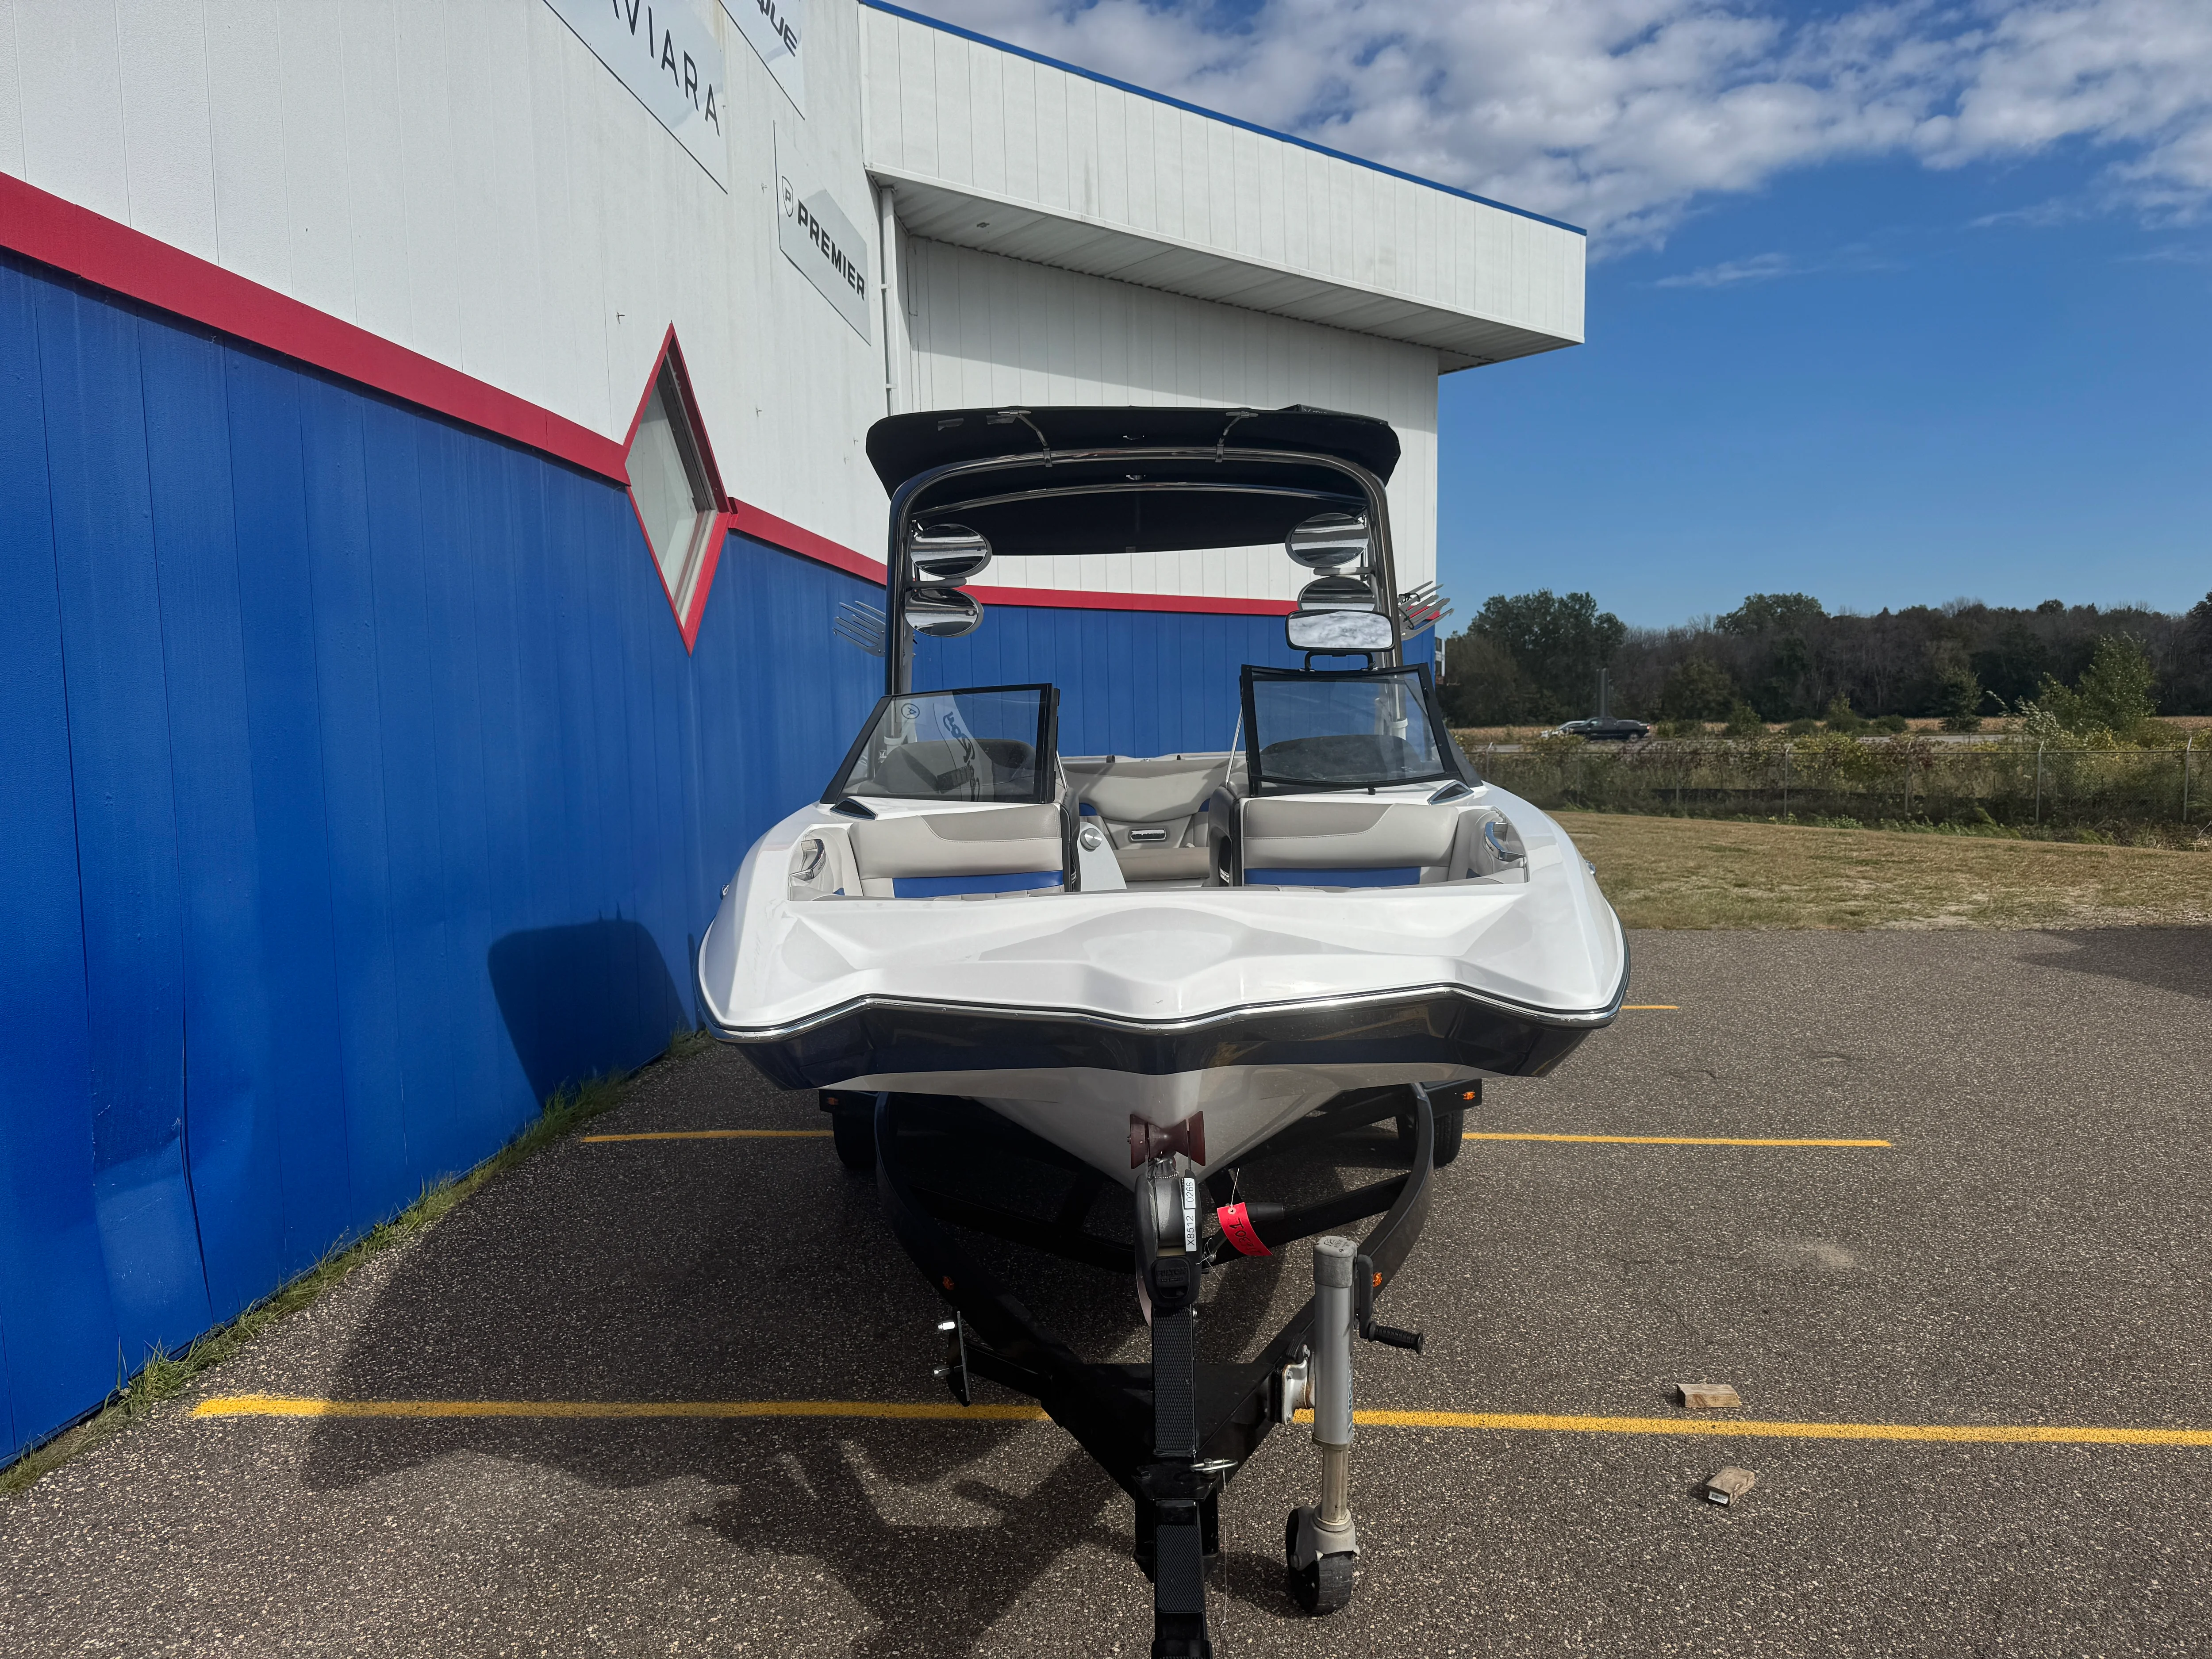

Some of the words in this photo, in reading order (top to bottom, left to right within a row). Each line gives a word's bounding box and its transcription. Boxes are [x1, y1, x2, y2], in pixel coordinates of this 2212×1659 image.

[613, 0, 720, 137] VIARA
[798, 198, 865, 301] PREMIER
[1187, 1215, 1195, 1245] X8512
